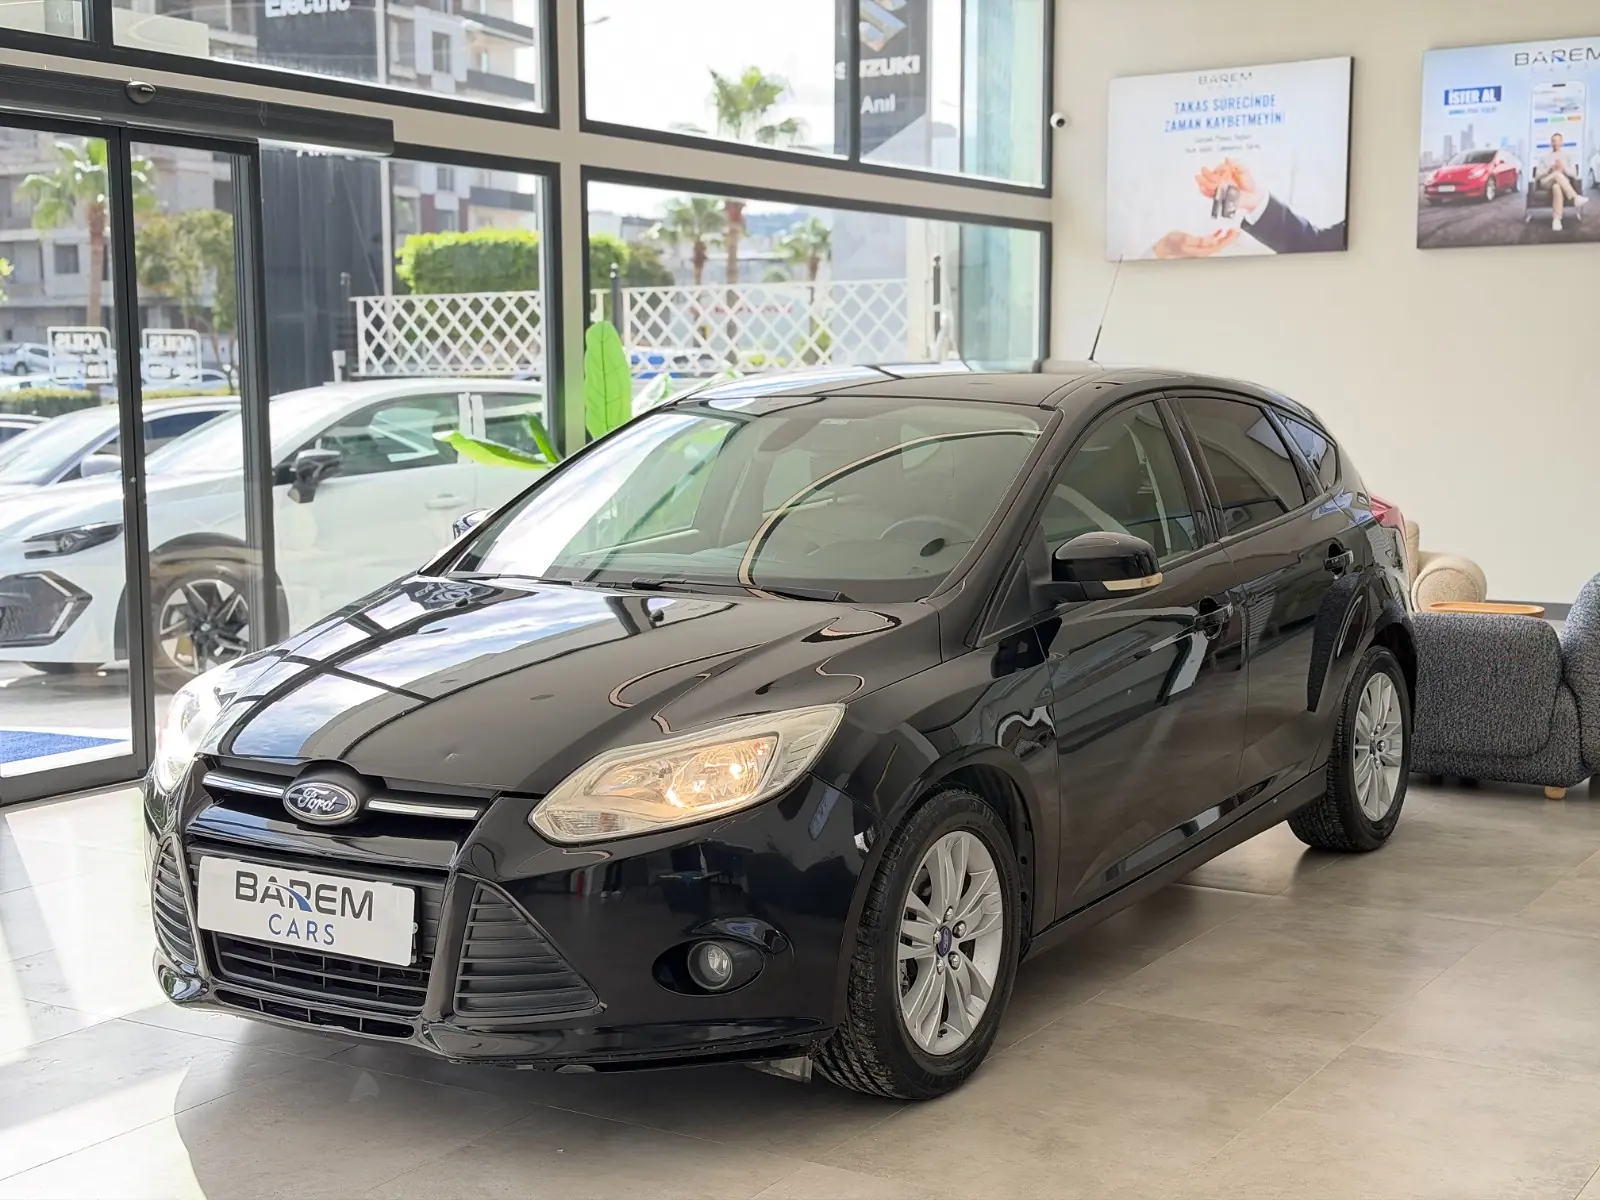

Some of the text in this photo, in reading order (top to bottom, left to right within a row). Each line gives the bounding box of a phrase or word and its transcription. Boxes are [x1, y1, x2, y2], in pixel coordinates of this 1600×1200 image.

[834, 55, 920, 79] SZUKI
[1174, 93, 1276, 114] TAKAS SÜRECİNDE
[1481, 87, 1496, 103] AL
[1164, 118, 1201, 133] ZAMAN
[297, 787, 337, 812] Ford
[235, 870, 374, 922] BAREM
[268, 913, 335, 946] CARS
